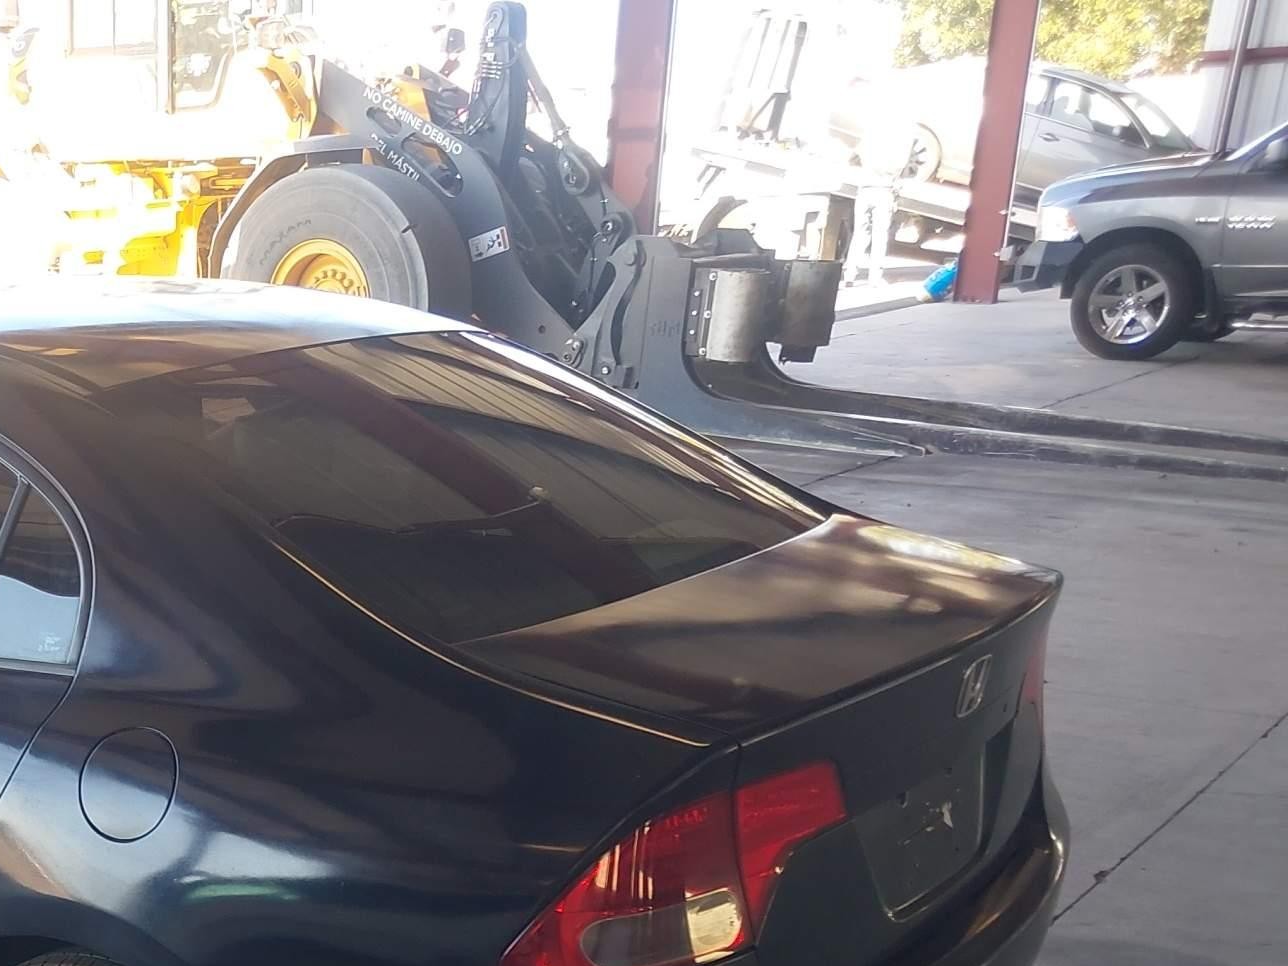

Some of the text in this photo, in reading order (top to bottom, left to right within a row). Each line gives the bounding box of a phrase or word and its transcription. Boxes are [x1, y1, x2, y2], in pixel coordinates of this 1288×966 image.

[363, 87, 463, 155] NO CAMINE DEBAJO
